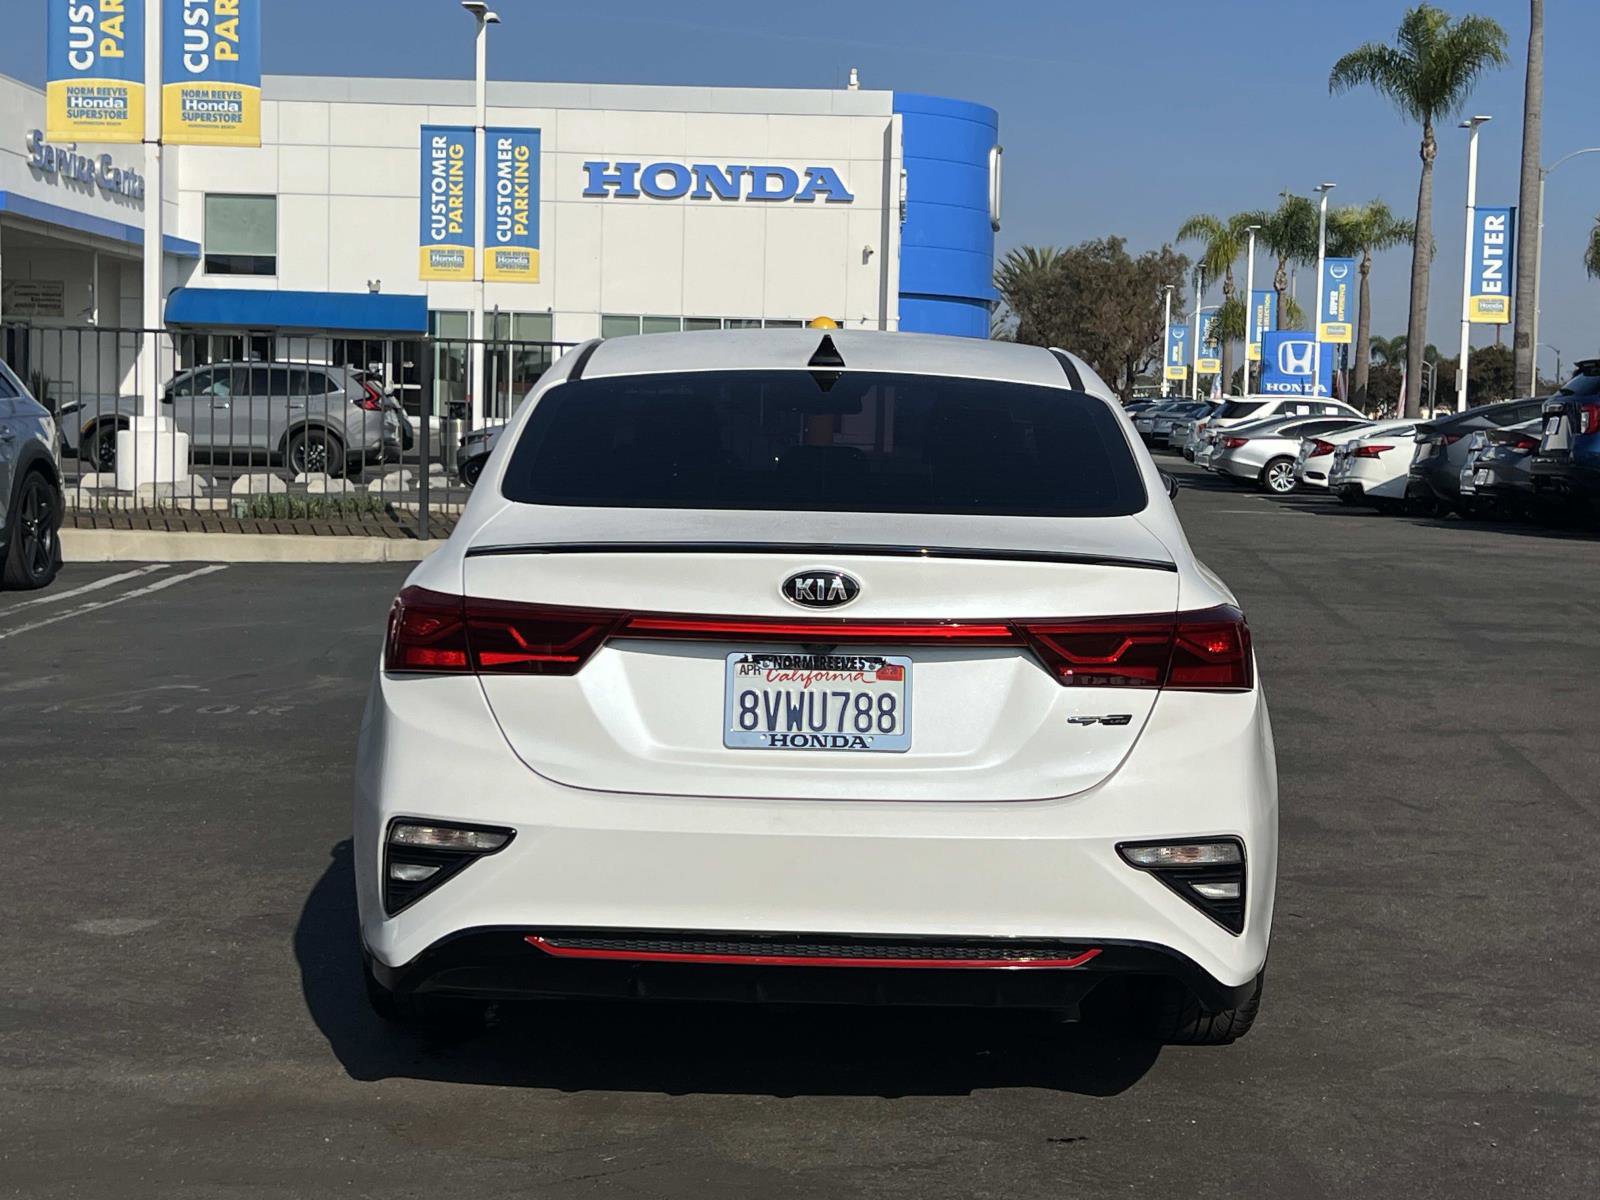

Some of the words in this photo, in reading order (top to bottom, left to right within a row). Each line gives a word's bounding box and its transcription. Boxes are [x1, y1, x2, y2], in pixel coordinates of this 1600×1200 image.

[67, 86, 95, 96] NORM
[96, 87, 128, 97] REEVES
[182, 89, 209, 99] NORM
[211, 90, 242, 100] REEVES
[70, 96, 125, 108] Honda
[185, 100, 239, 112] Honda
[67, 109, 128, 120] SUPERSTORE
[181, 112, 242, 123] SUPERSTORE
[26, 129, 95, 185] Service
[431, 136, 447, 240] CUSTOMER
[448, 144, 464, 234] PARKING
[496, 138, 513, 242] CUSTOMER
[514, 145, 530, 236] PARKING
[582, 161, 855, 204] HONDA
[432, 254, 463, 262] Honda
[497, 255, 528, 264] Honda
[1481, 214, 1505, 293] ENTER
[794, 577, 848, 601] KIA
[739, 664, 761, 677] APR
[772, 655, 814, 670] NORM
[816, 656, 866, 671] REEVES
[766, 668, 877, 689] California
[739, 689, 897, 734] 8VWU788
[768, 733, 870, 749] HONDA
